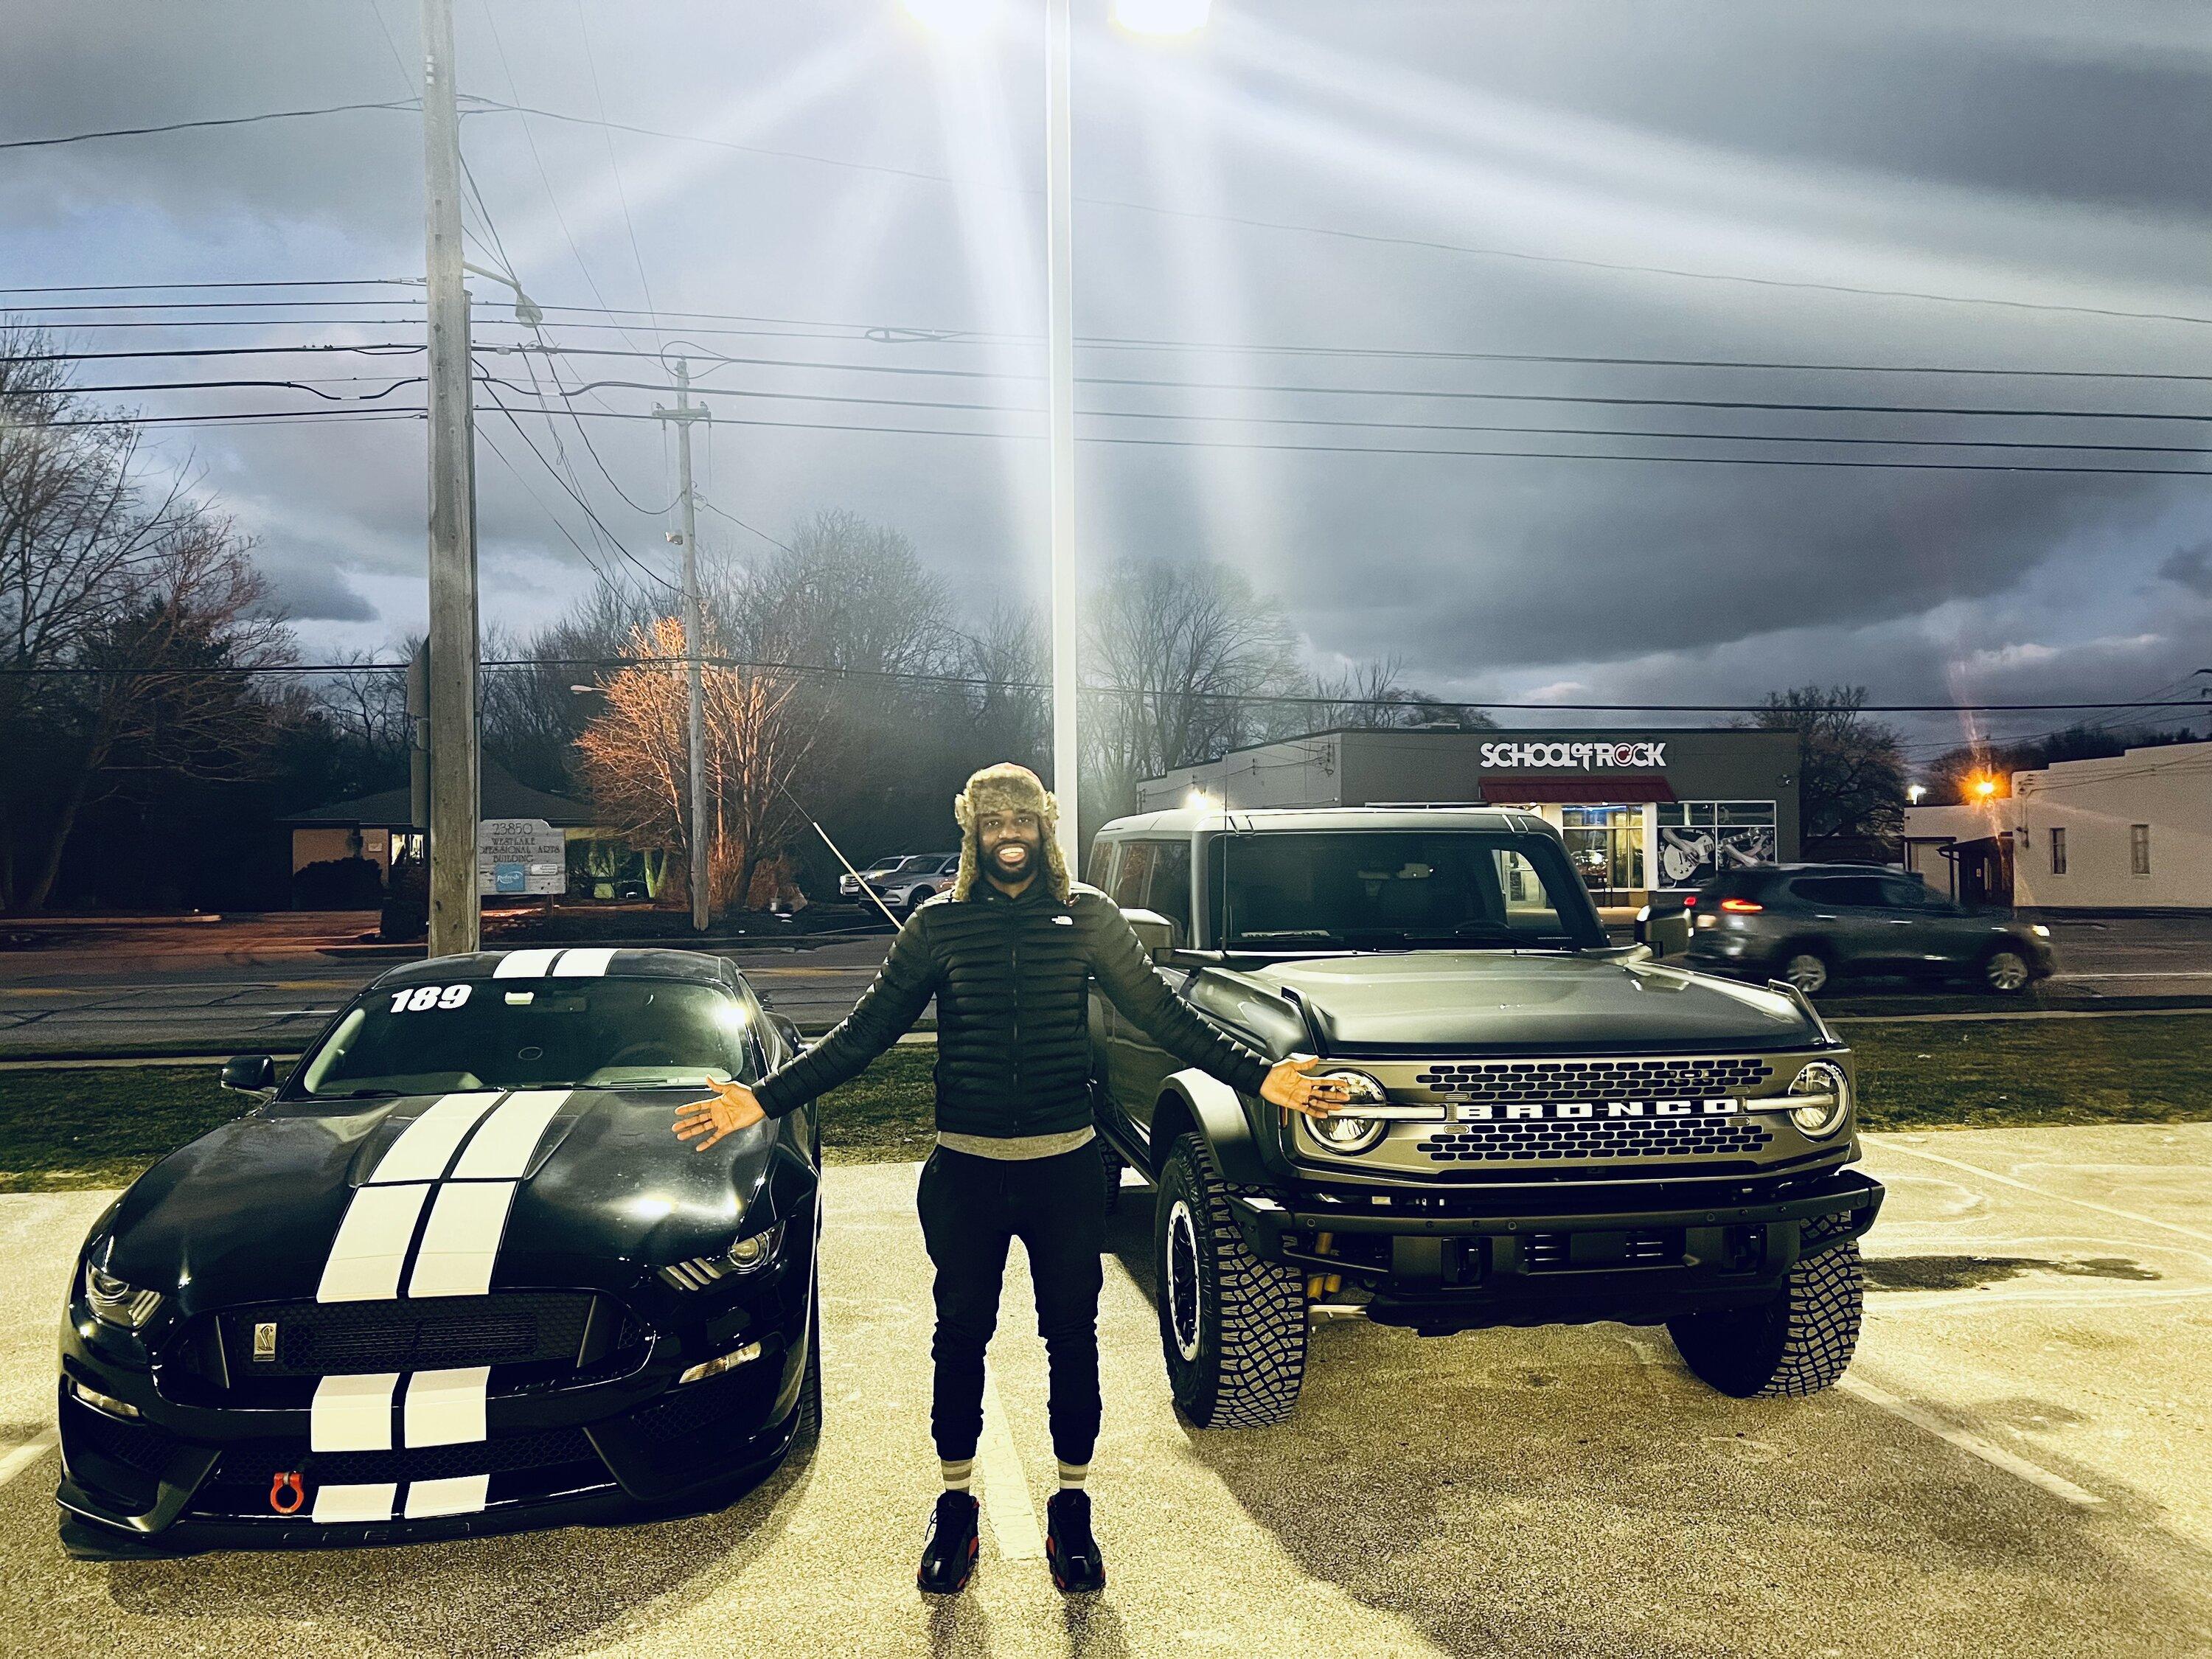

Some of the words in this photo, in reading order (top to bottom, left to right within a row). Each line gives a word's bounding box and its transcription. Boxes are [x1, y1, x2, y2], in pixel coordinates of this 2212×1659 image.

[1480, 742, 1578, 768] SCHOOL
[1594, 742, 1666, 768] ROCK
[492, 823, 533, 835] 23850
[491, 838, 535, 846] WESTLAKE
[479, 846, 531, 855] OFESSIONAL
[538, 846, 560, 854] ARTS
[390, 984, 473, 1013] 189
[1456, 1099, 1739, 1119] BRONCO
